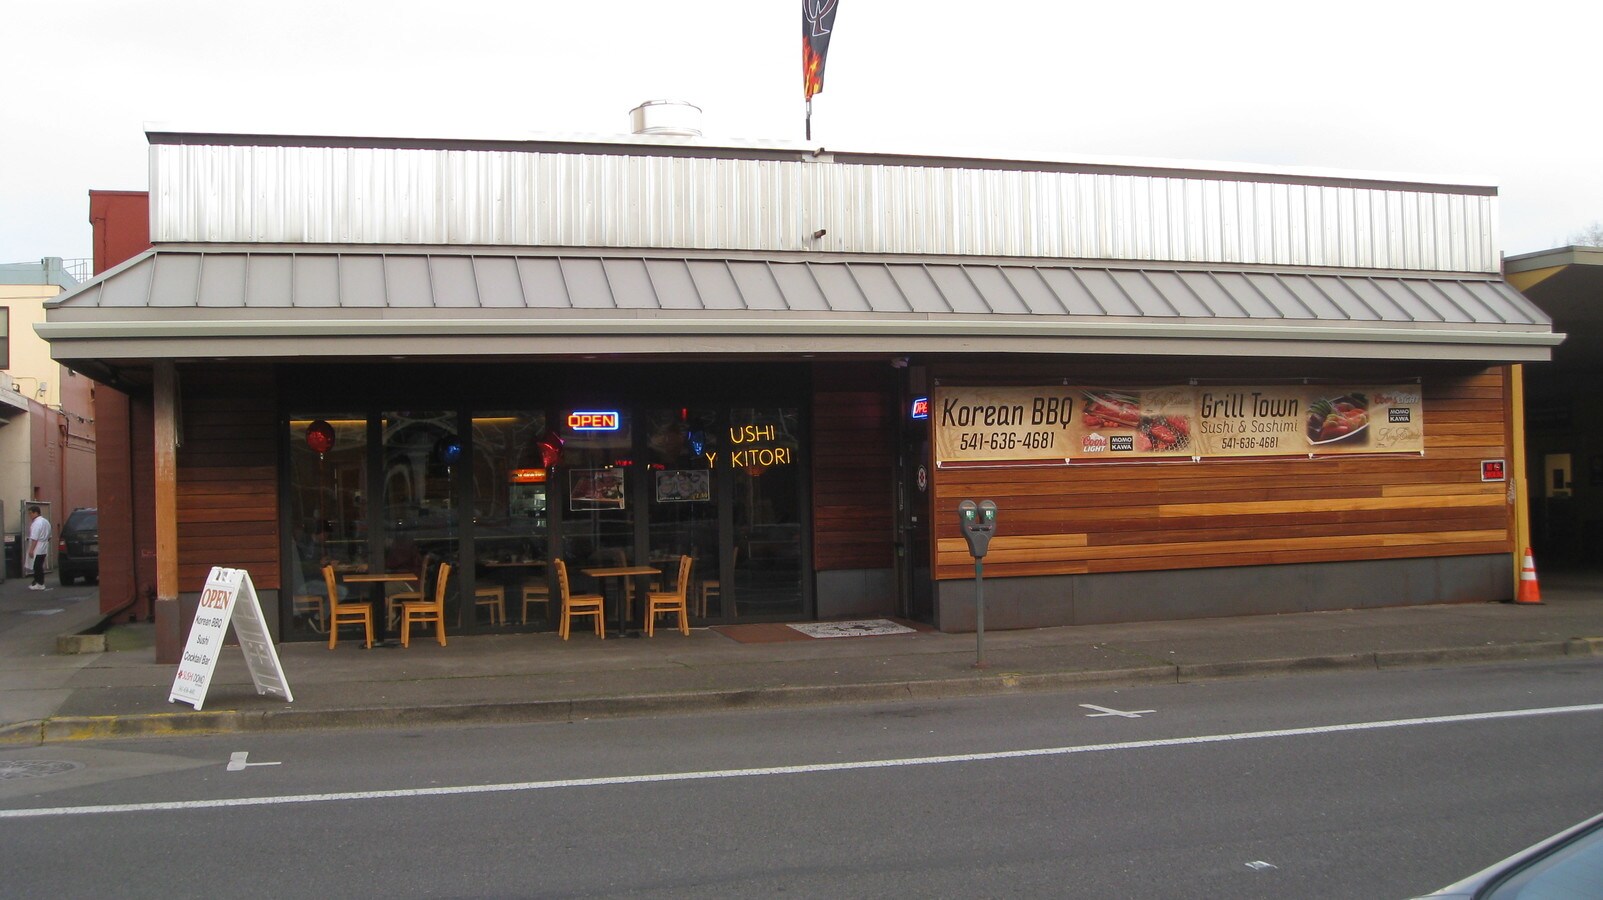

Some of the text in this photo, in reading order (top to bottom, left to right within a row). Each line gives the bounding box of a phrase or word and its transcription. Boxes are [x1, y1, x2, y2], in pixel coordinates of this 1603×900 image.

[915, 401, 928, 414] OPE
[1201, 392, 1245, 418] Grill
[1251, 392, 1299, 417] Town
[942, 397, 1073, 429] Korean BBQ
[568, 415, 615, 428] OPEN
[1200, 420, 1298, 434] Sushi & Sashimi
[960, 431, 1055, 450] 541-636-4681
[1221, 436, 1279, 450] 541-636-4681
[1083, 445, 1106, 453] LIGHT
[201, 588, 232, 610] OPEN
[195, 615, 223, 628] Korean BBQ
[196, 634, 210, 645] Sushi
[184, 651, 210, 665] Cocktail Bar
